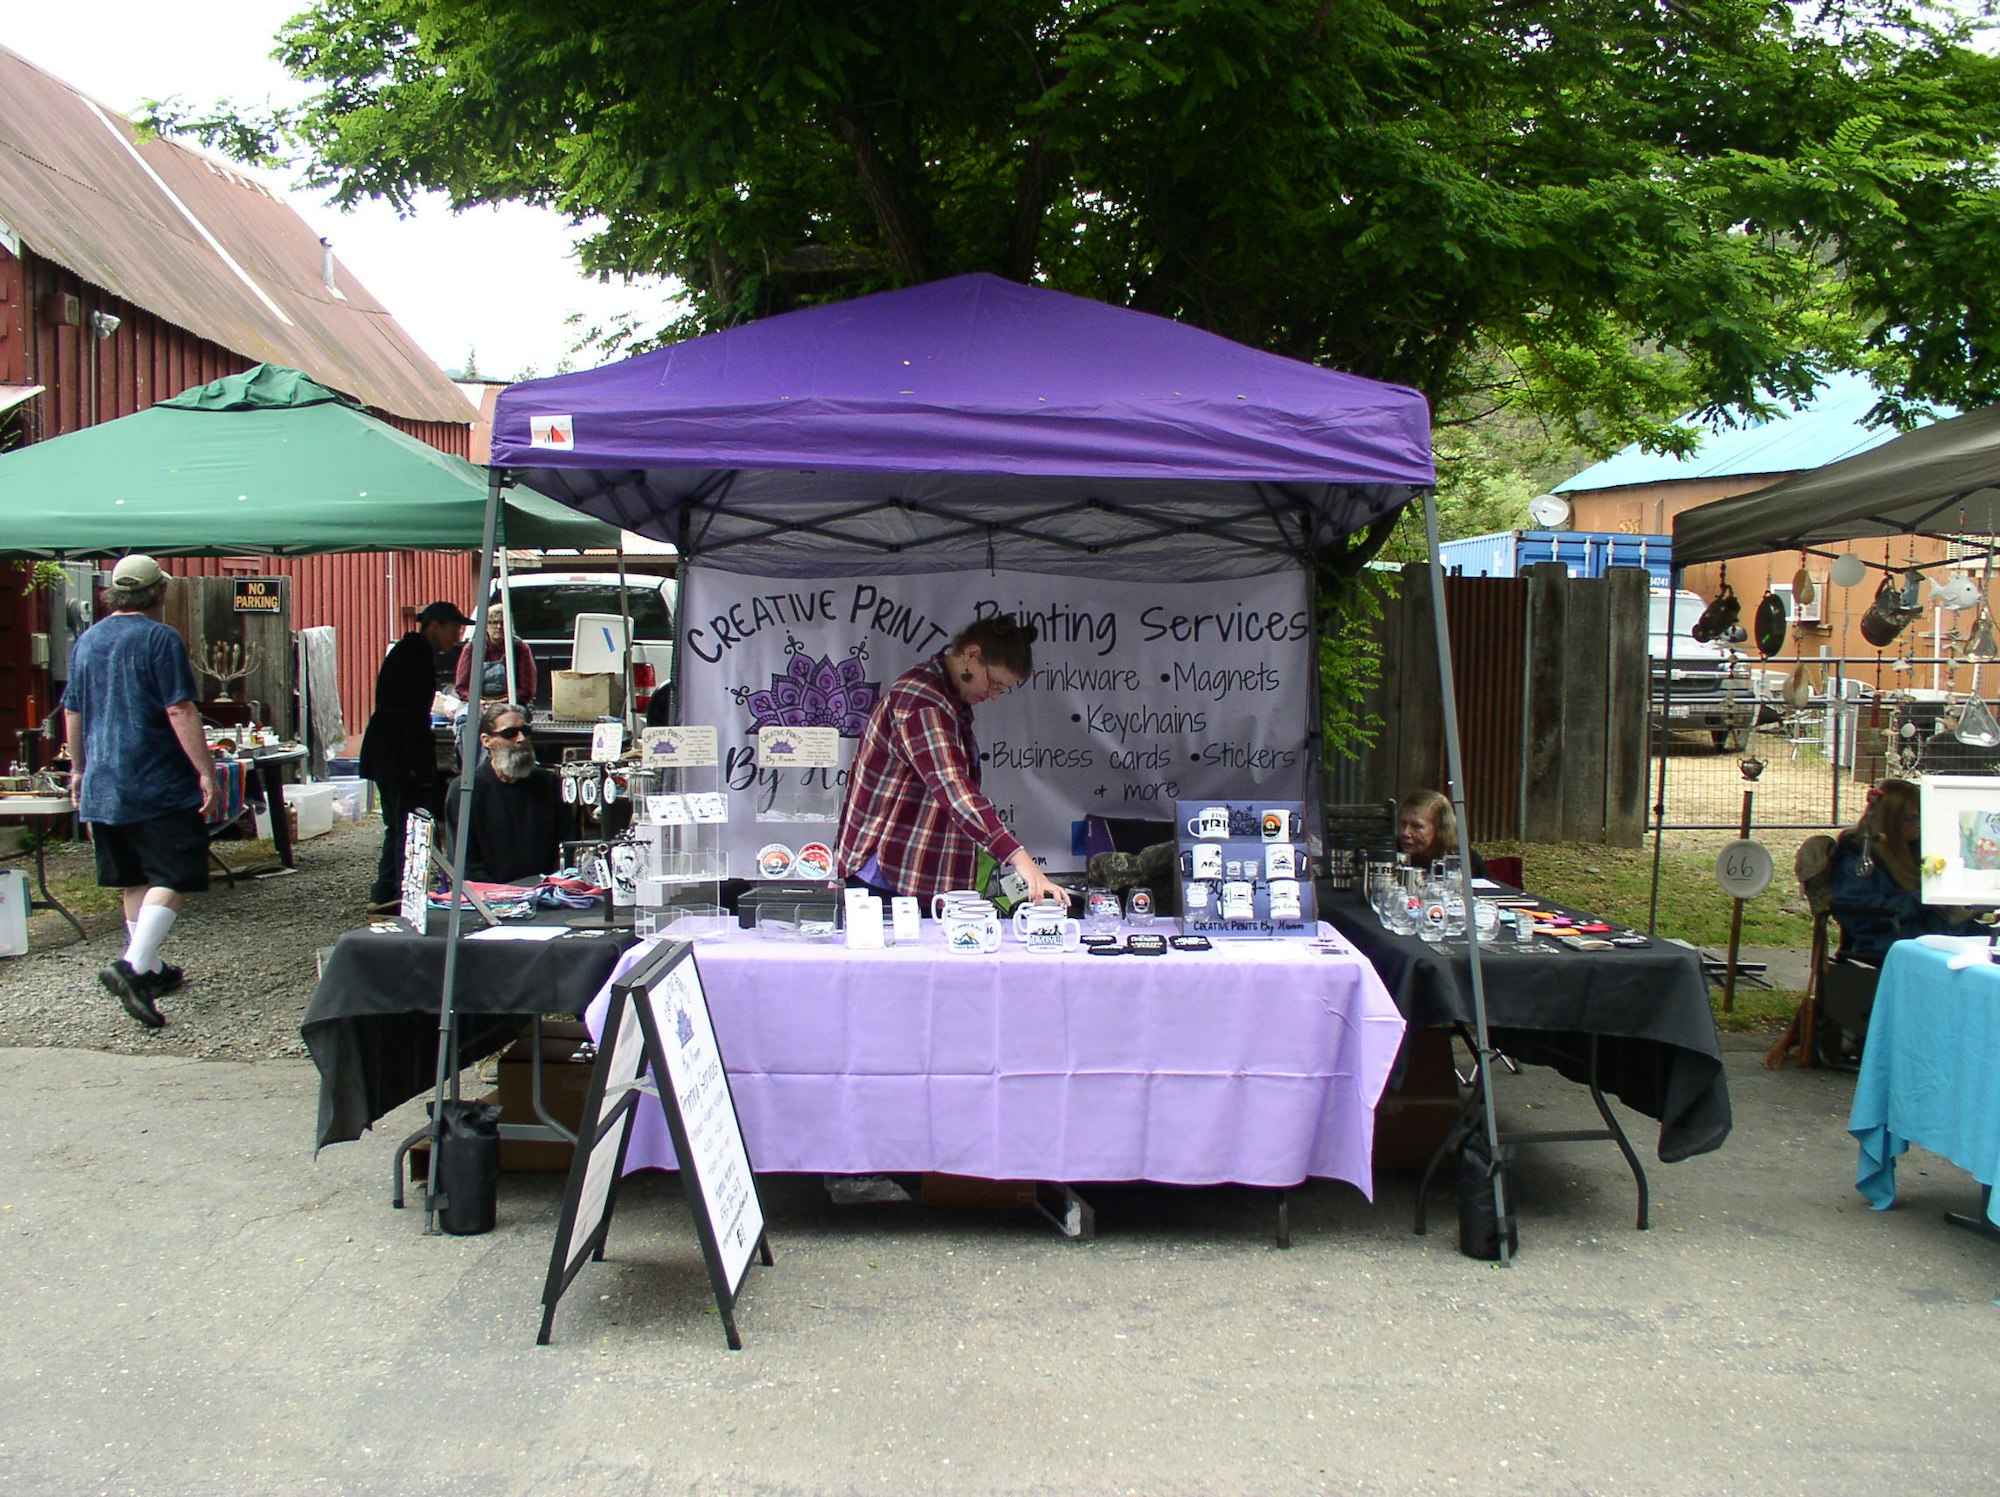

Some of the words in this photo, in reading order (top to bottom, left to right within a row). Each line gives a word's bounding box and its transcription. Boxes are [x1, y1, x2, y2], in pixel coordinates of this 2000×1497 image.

[236, 596, 278, 608] PARKING
[248, 583, 265, 595] NO
[687, 590, 837, 664] CREATIVE
[1140, 602, 1309, 642] Services
[1016, 662, 1141, 692] rinkware
[1174, 661, 1281, 701] Magnets
[1086, 704, 1207, 744] Keychains
[992, 741, 1094, 769] Business
[1109, 744, 1171, 771] cards
[1202, 743, 1296, 770] Stickers
[726, 746, 785, 814] By
[1123, 779, 1181, 801] more
[1726, 855, 1754, 878] 66
[1193, 920, 1229, 931] CREATIVE
[1231, 920, 1258, 931] PRINTS
